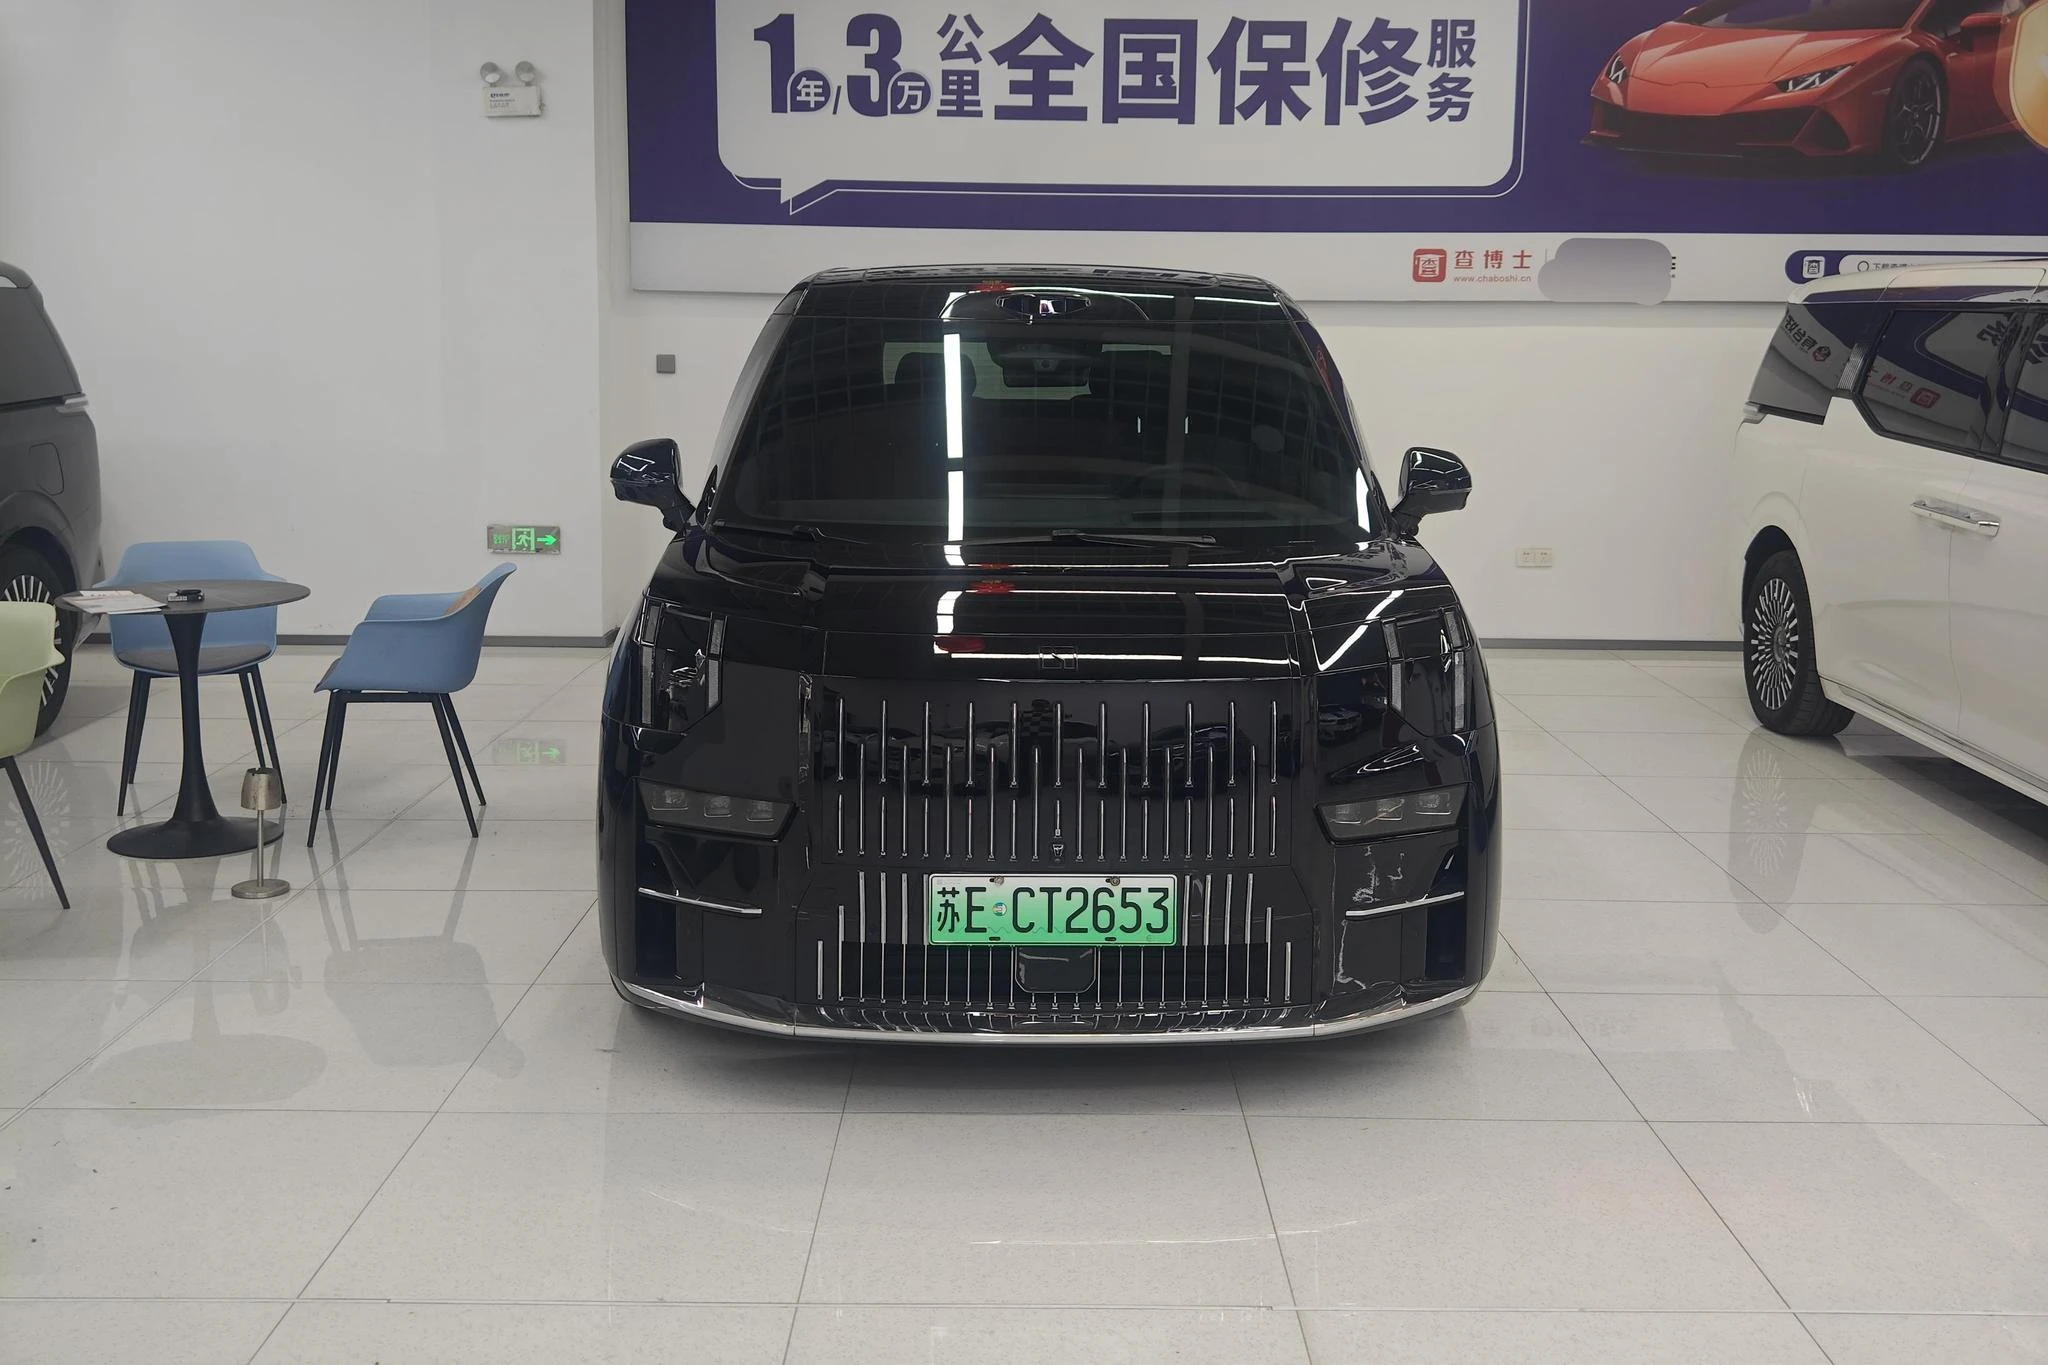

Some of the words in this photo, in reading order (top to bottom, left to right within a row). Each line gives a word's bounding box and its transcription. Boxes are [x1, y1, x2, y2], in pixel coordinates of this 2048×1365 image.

[1454, 249, 1533, 270] 查博士
[1453, 274, 1532, 283] www.chaboshi.cn
